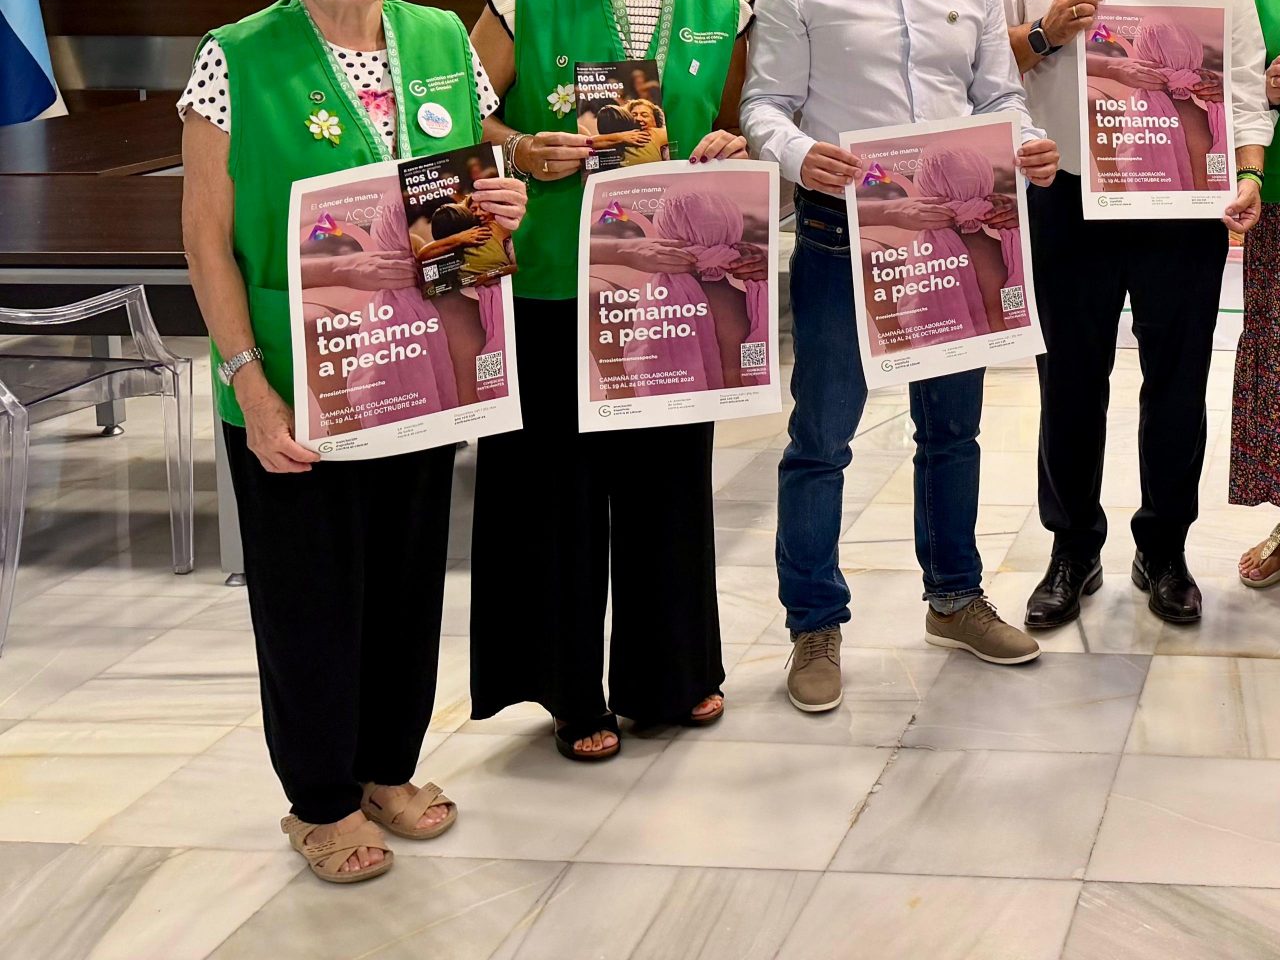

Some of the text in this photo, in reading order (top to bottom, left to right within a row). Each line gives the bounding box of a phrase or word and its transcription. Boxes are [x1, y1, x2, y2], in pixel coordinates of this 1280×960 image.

[578, 82, 624, 91] tomamos
[596, 73, 605, 82] lo
[588, 90, 621, 100] pecho.
[1095, 95, 1148, 111] nos lo
[1095, 112, 1178, 128] tomamos
[1096, 129, 1170, 148] a pecho.
[405, 170, 439, 186] nos lo
[406, 174, 460, 195] tomamos
[354, 194, 377, 203] mama
[419, 187, 457, 205] pecho.
[871, 239, 932, 264] nos lo
[871, 254, 968, 282] tomamos
[599, 282, 668, 304] nos lo
[874, 274, 960, 302] a pecho.
[316, 302, 393, 332] nos lo
[599, 302, 707, 324] tomamos
[316, 317, 438, 354] tomamos
[599, 321, 695, 347] a pecho.
[318, 342, 426, 377] a pecho.
